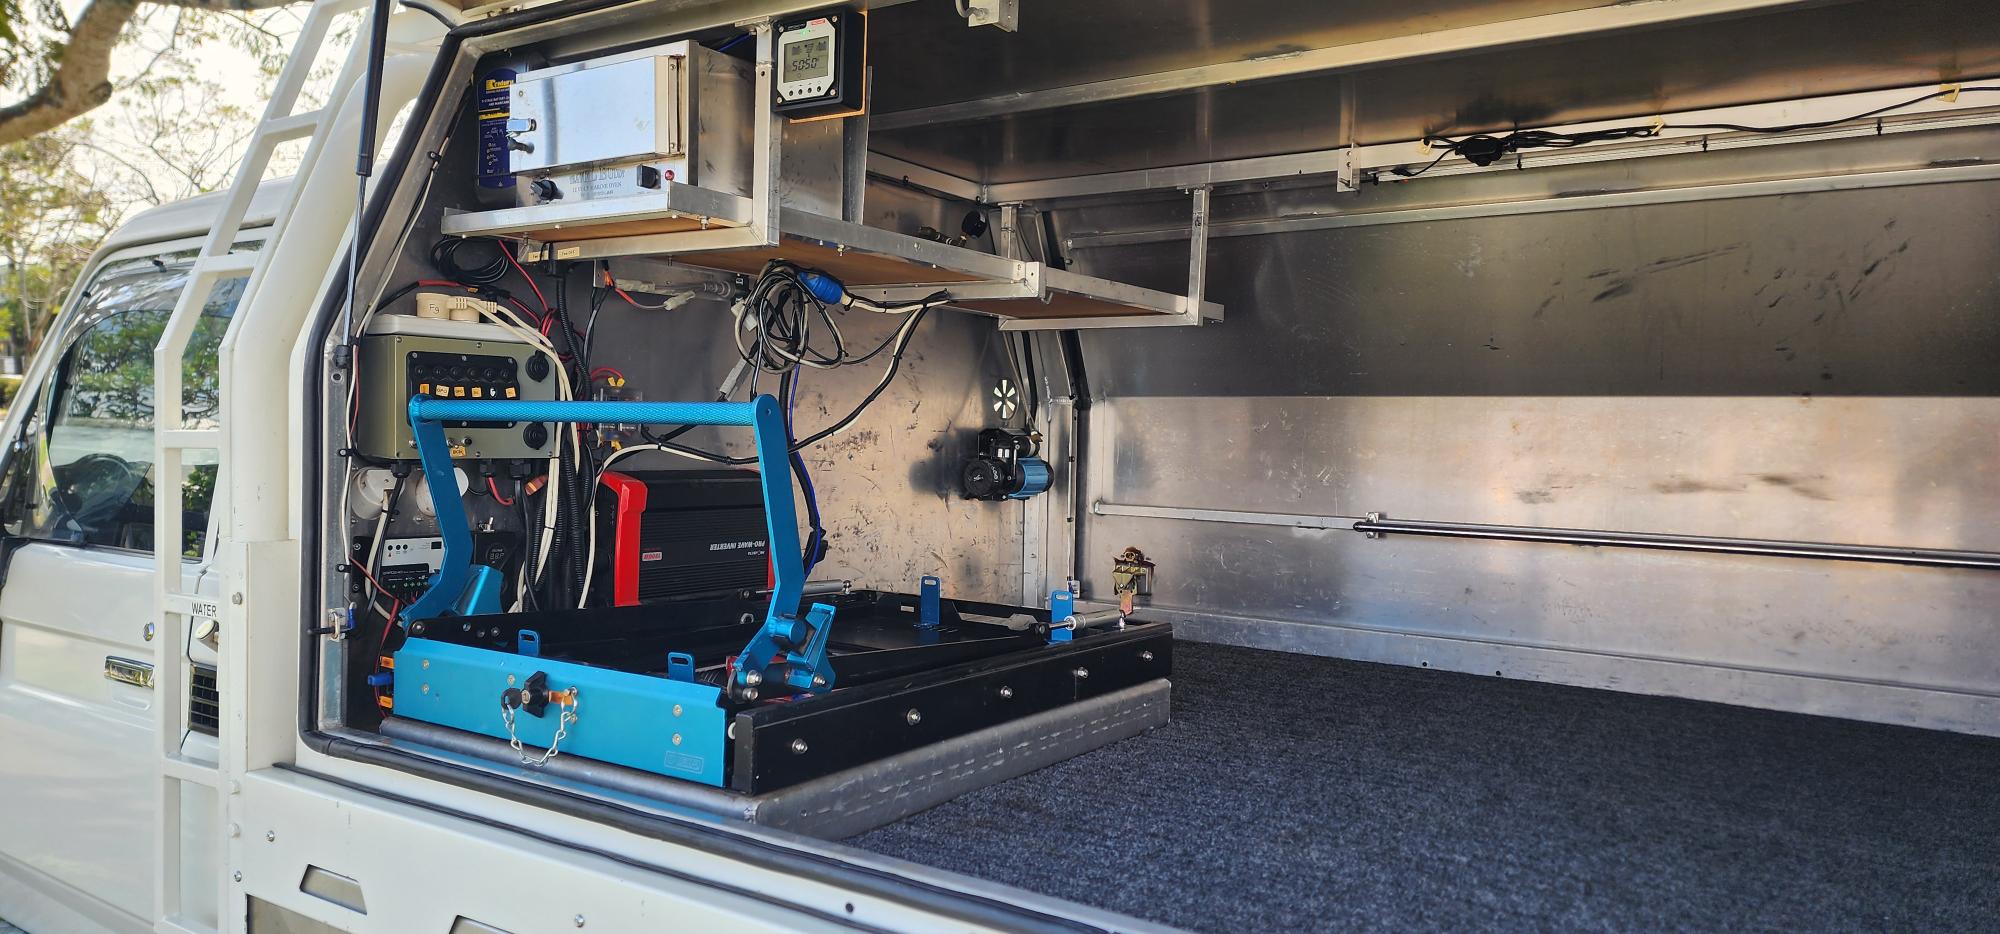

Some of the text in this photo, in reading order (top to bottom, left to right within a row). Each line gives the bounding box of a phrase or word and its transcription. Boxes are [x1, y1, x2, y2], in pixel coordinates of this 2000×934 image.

[710, 540, 766, 551] PRO-WAVE INVERTER
[192, 602, 217, 617] WATER
